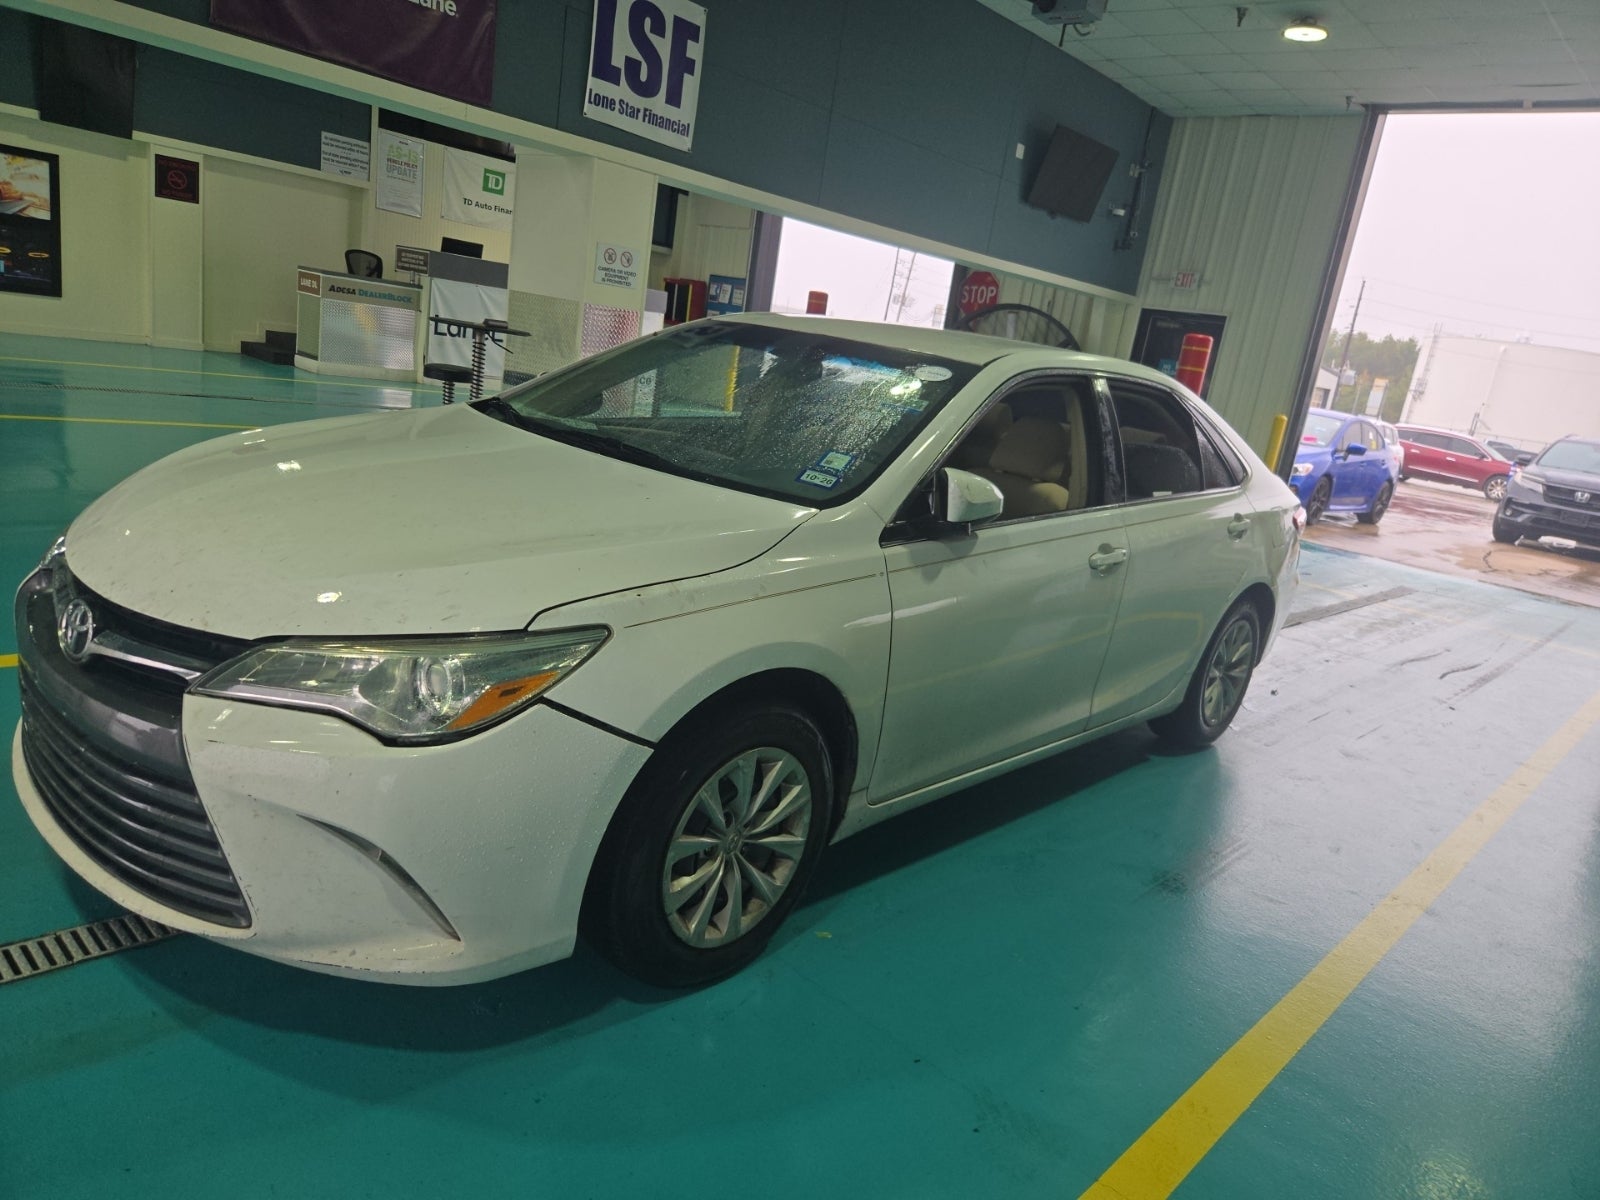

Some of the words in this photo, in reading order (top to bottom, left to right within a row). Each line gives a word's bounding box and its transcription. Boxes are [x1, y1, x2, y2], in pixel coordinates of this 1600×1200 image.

[592, 0, 700, 109] LSF
[588, 88, 616, 112] Lone
[618, 98, 641, 120] Star
[642, 107, 690, 138] Financial
[386, 165, 417, 180] UPDATE
[485, 172, 503, 190] TD
[463, 197, 473, 206] TD
[474, 201, 493, 211] Auto
[1175, 273, 1194, 288] EXIT
[961, 285, 997, 304] STOP
[434, 314, 488, 341] Lan
